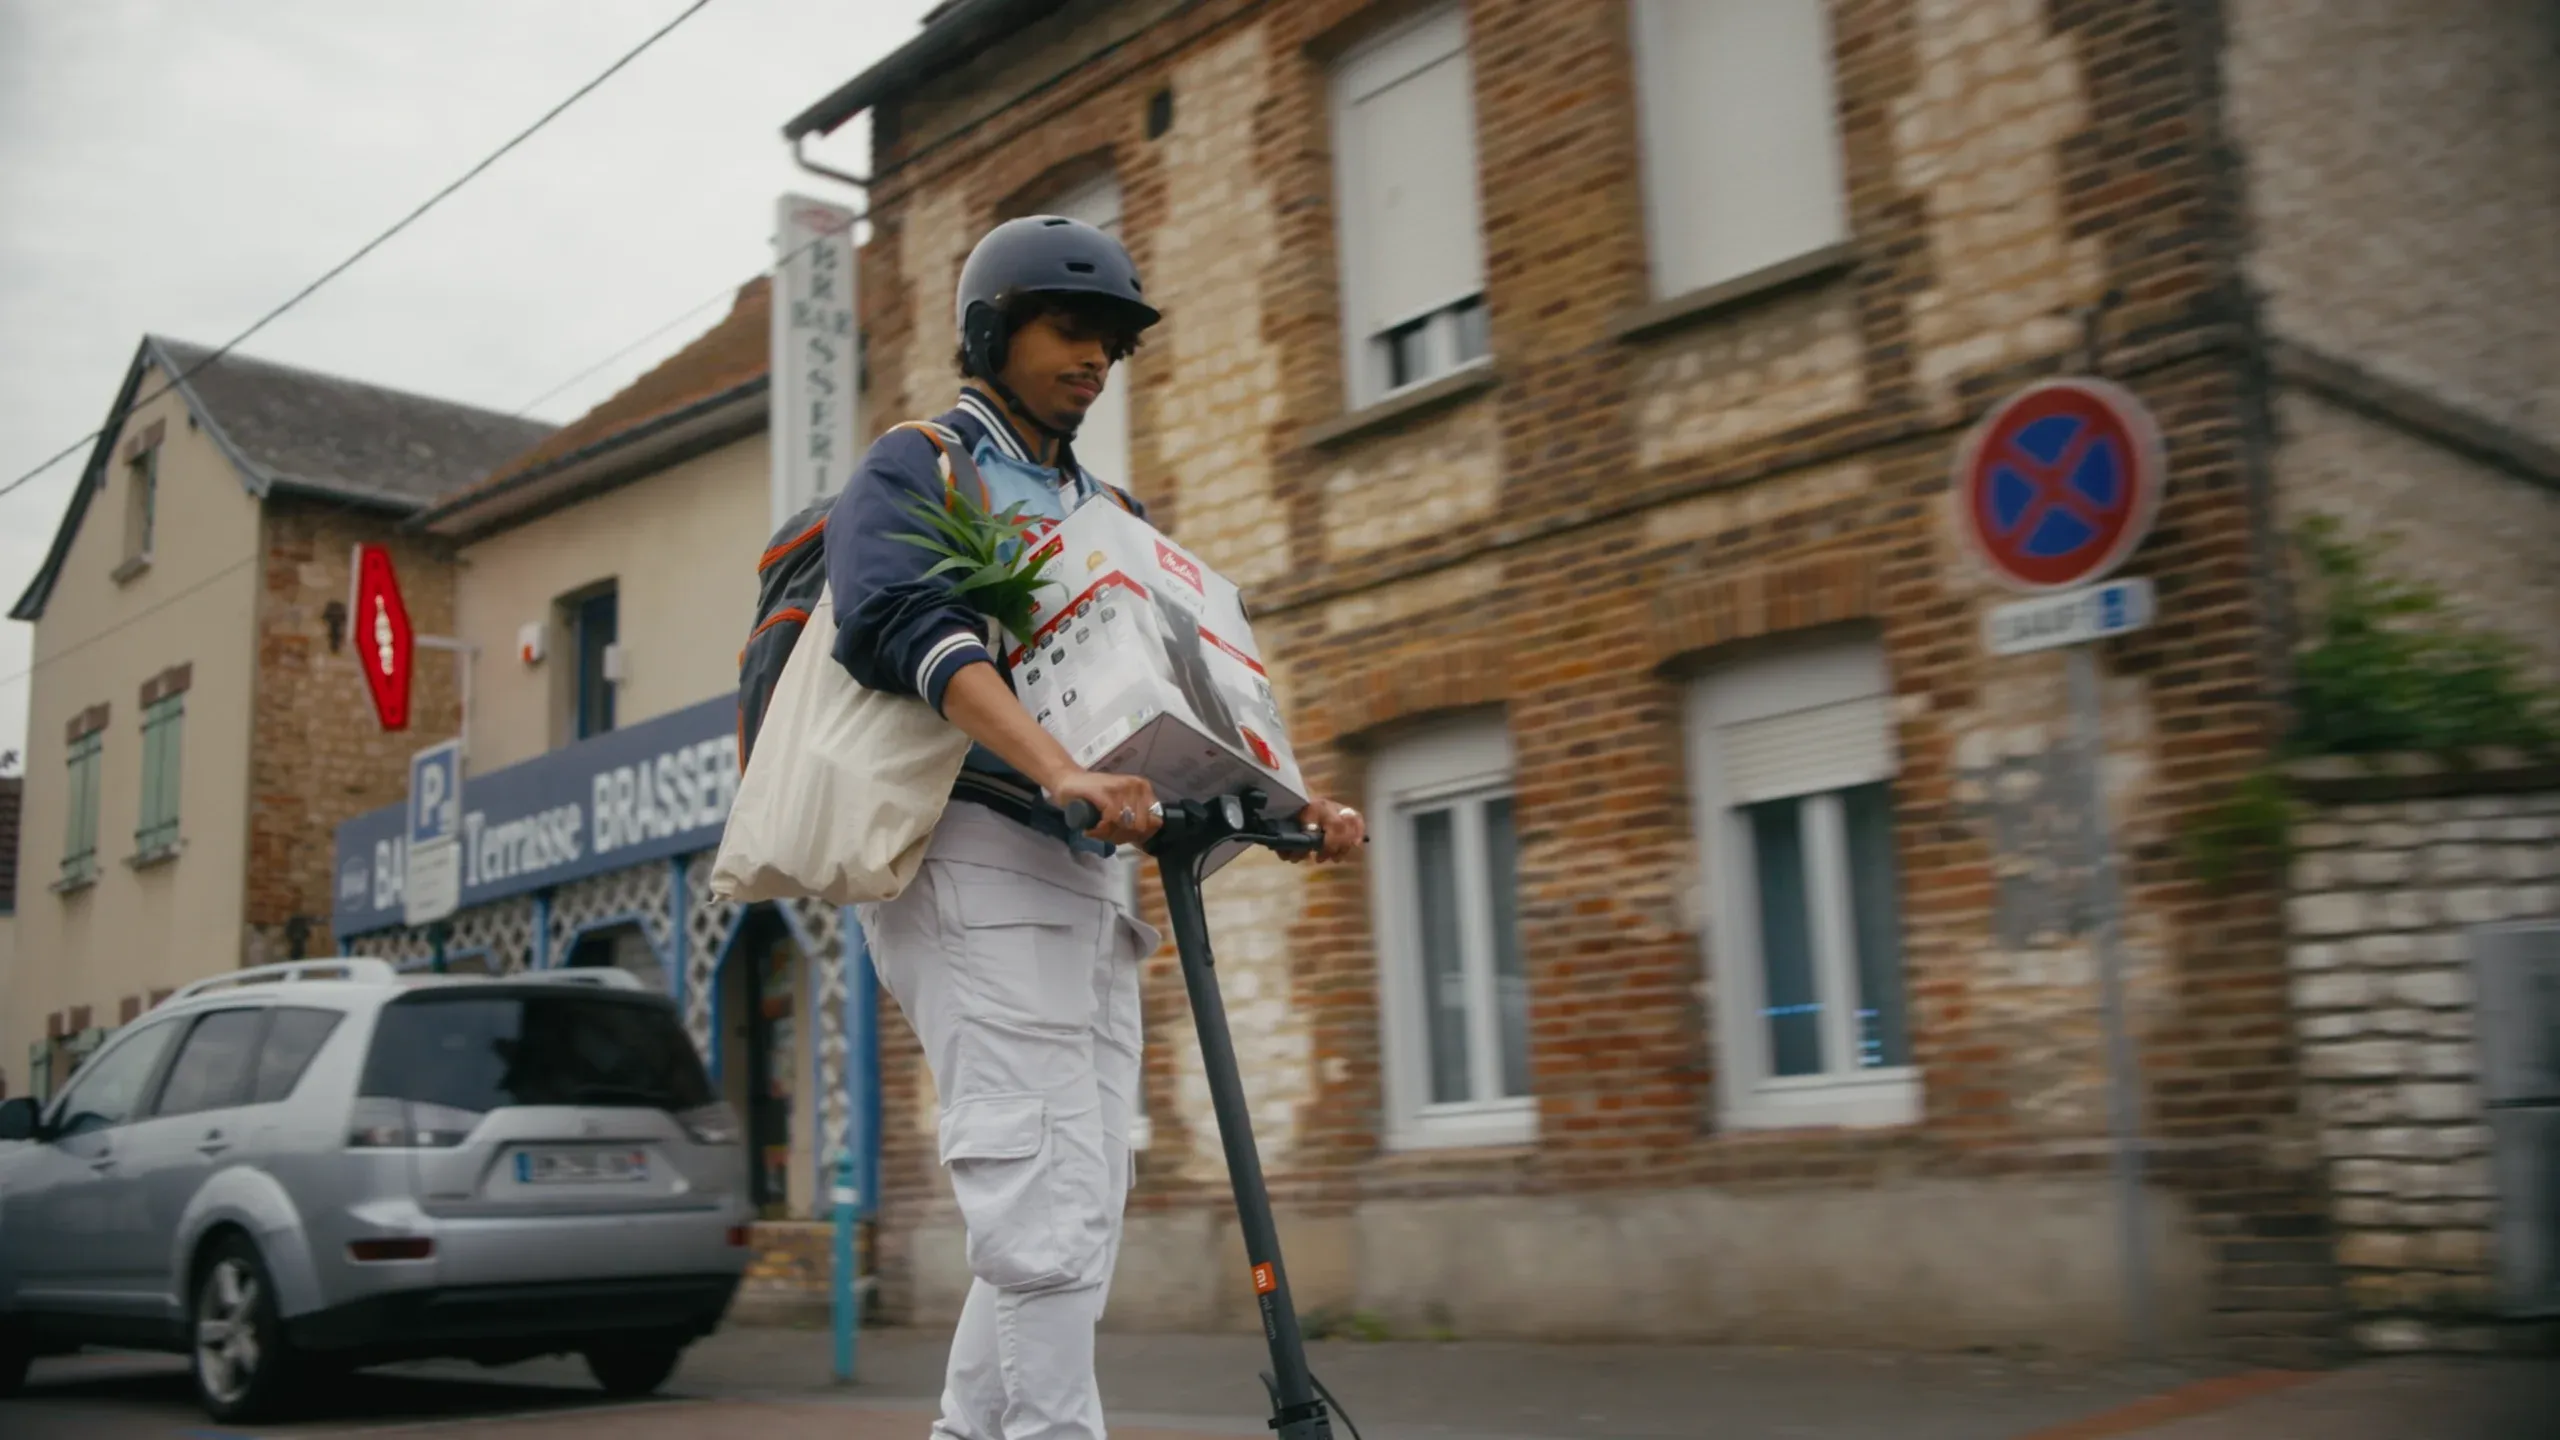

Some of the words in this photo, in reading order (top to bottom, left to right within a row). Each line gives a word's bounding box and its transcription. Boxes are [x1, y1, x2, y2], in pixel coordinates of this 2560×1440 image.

[373, 834, 406, 911] BA
[465, 803, 582, 887] Terrasse
[592, 733, 741, 854] BRASSER
[420, 763, 445, 827] P
